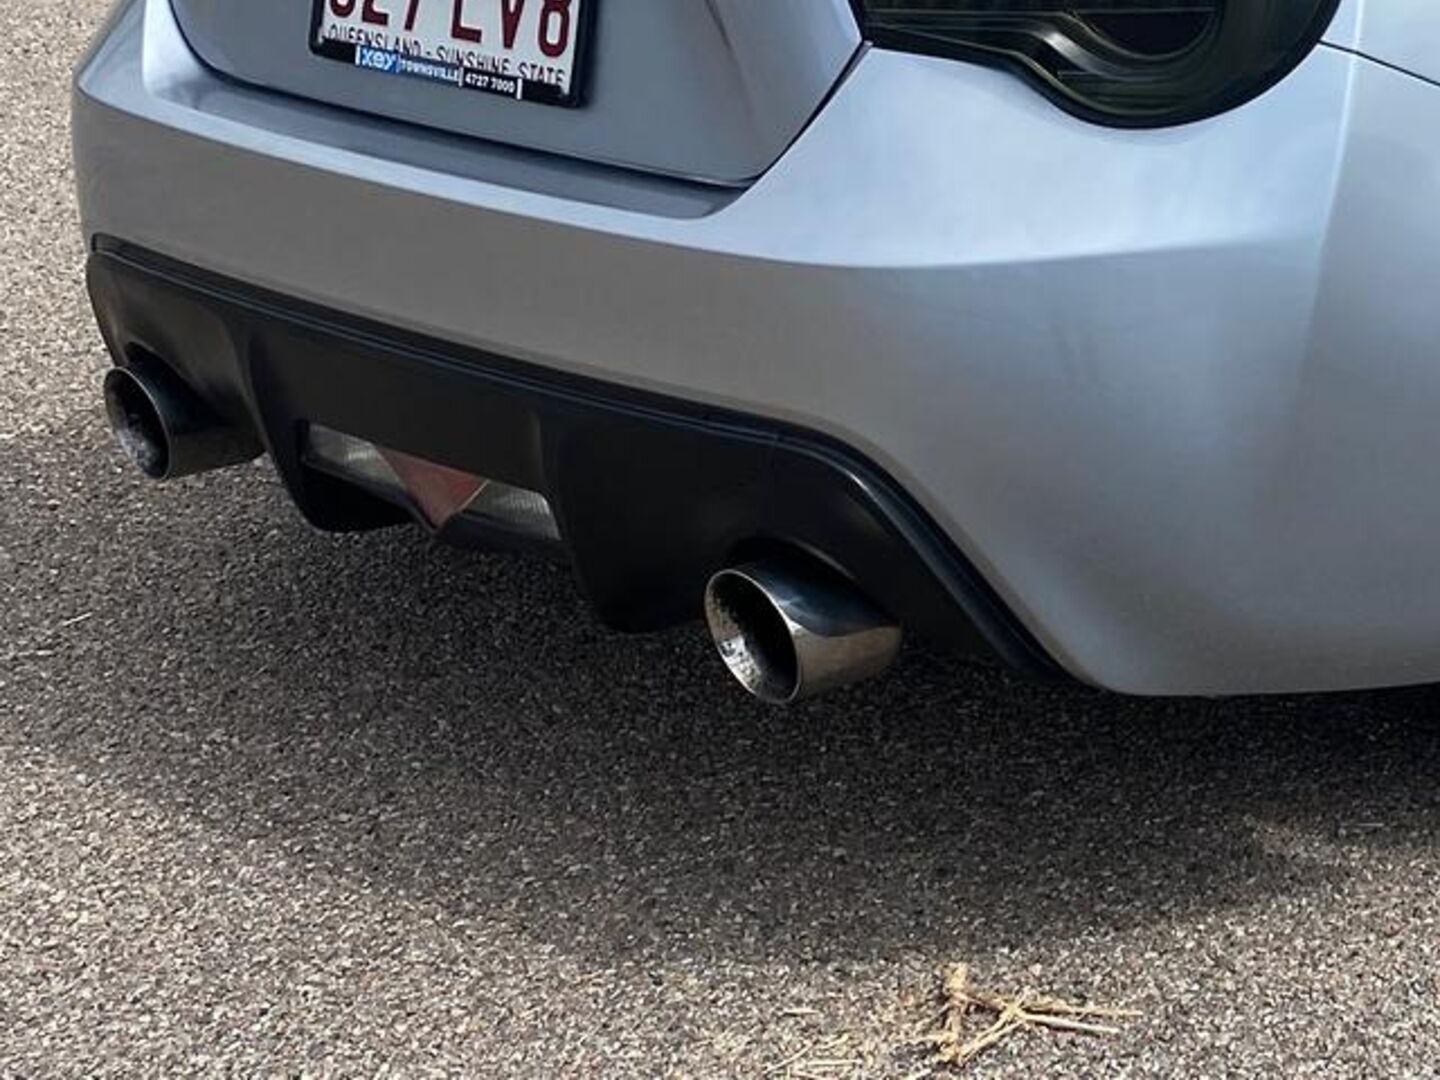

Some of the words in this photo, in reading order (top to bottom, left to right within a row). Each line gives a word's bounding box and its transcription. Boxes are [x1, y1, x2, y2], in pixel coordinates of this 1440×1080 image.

[326, 24, 421, 58] QUEENSLAND
[436, 45, 510, 78] SUNSHINE
[519, 61, 566, 86] STATE
[401, 59, 459, 82] TOWNSVILLE
[465, 72, 488, 87] 4727
